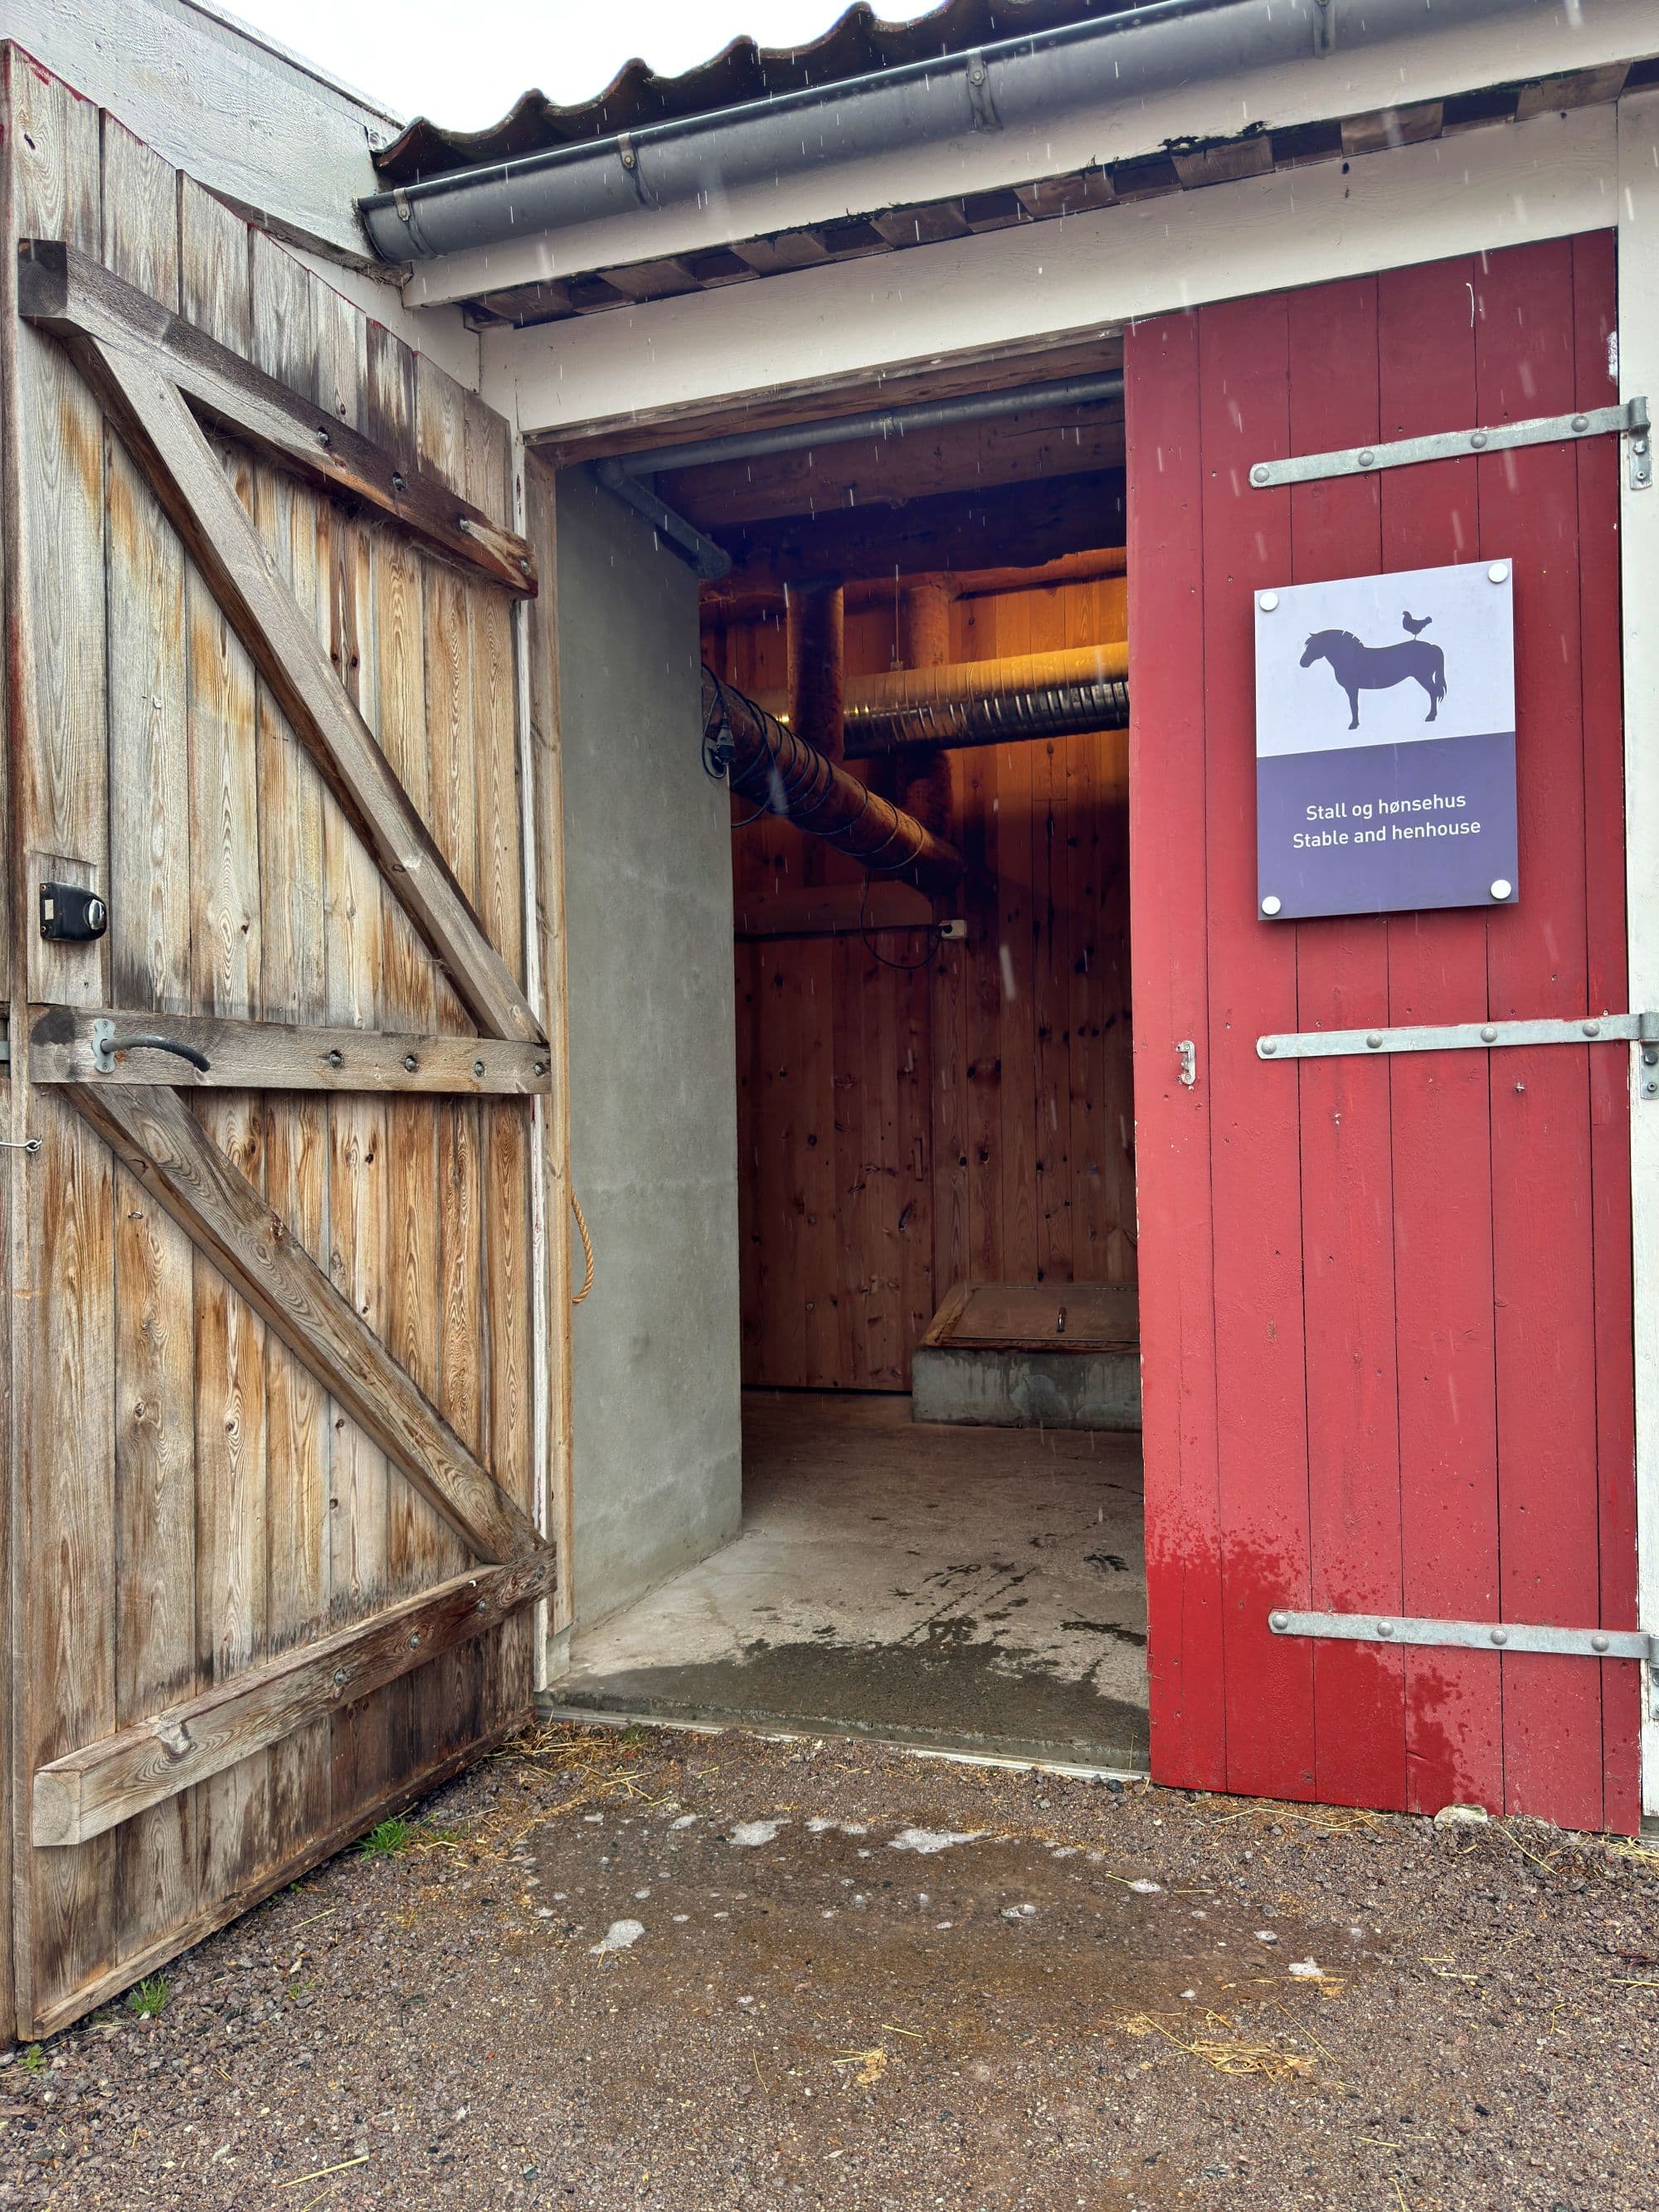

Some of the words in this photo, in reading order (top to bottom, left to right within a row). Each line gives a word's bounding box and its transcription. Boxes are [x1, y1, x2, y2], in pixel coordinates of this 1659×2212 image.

[1306, 802, 1348, 821] Stall
[1351, 804, 1373, 819] og
[1378, 794, 1467, 814] hønsehus
[1292, 829, 1350, 848] Stable
[1354, 825, 1386, 843] and
[1392, 821, 1481, 840] henhouse
